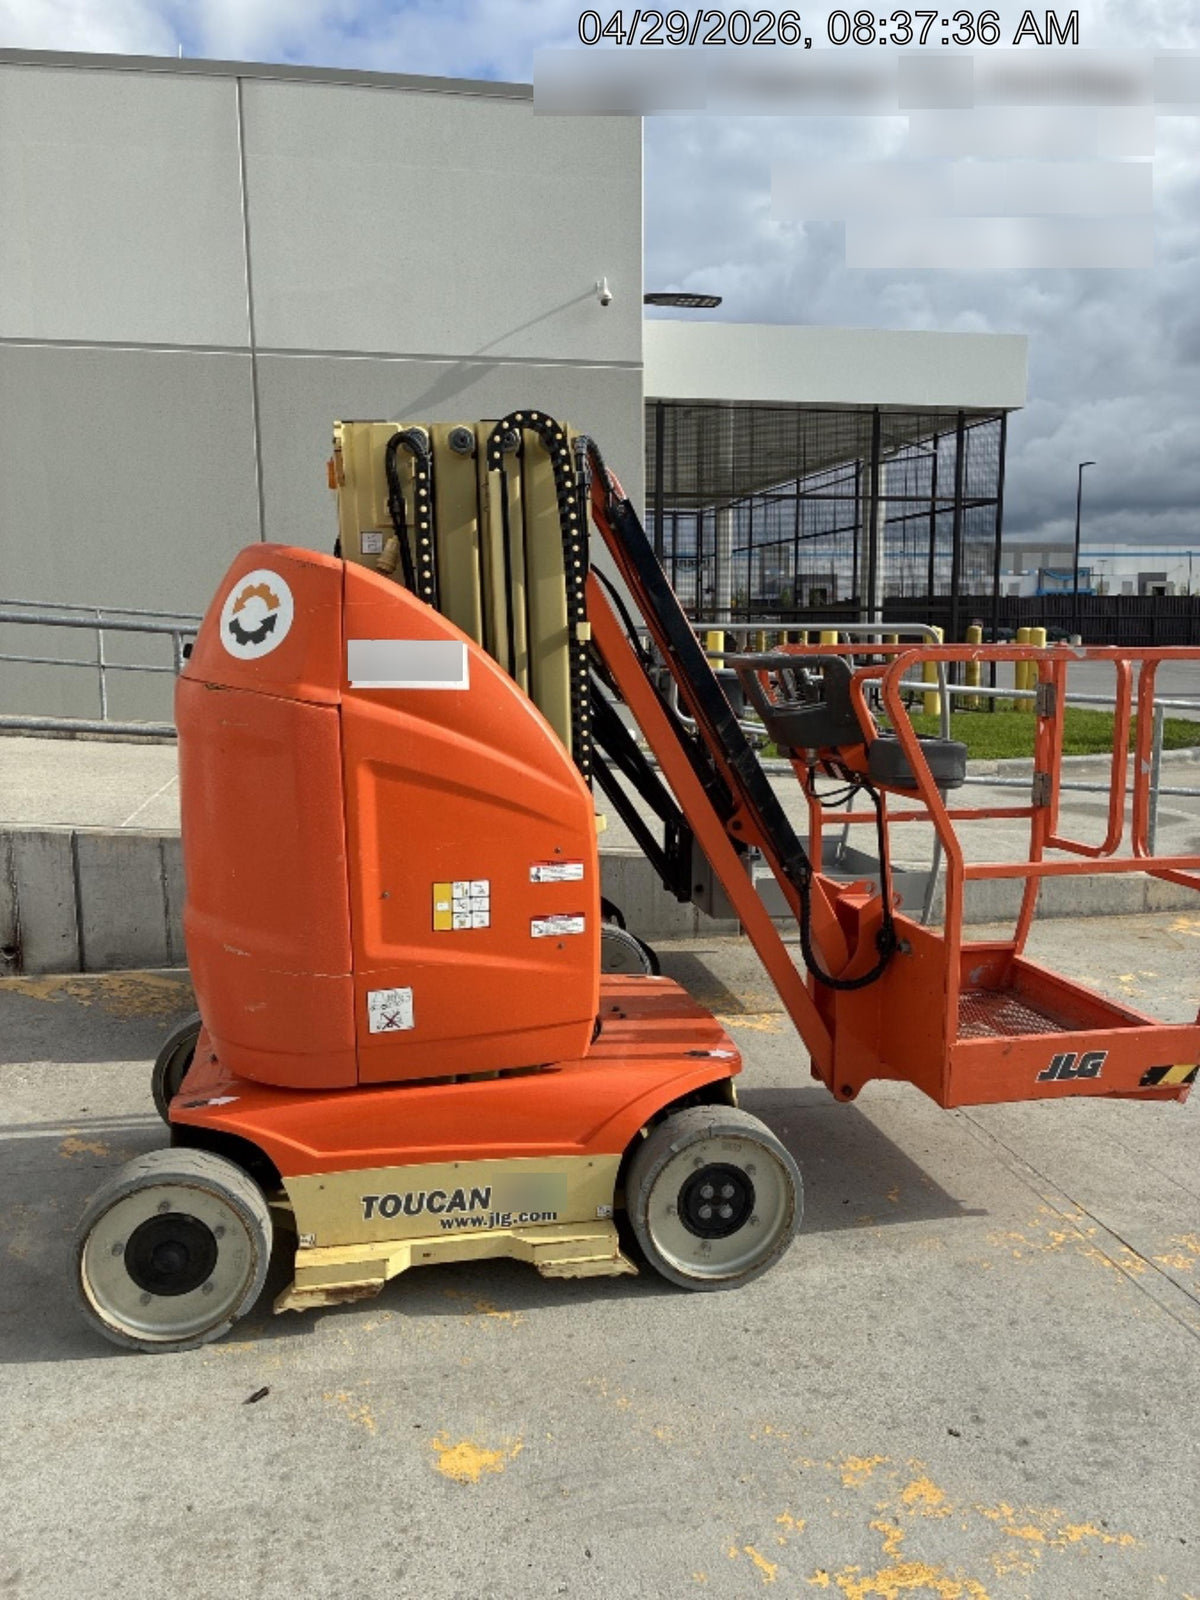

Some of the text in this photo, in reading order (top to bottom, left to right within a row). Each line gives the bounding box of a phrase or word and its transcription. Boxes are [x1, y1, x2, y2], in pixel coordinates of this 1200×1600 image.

[1036, 1051, 1109, 1082] JLG
[361, 1187, 491, 1219] TOUCAN
[440, 1212, 557, 1229] www.jlg.com
